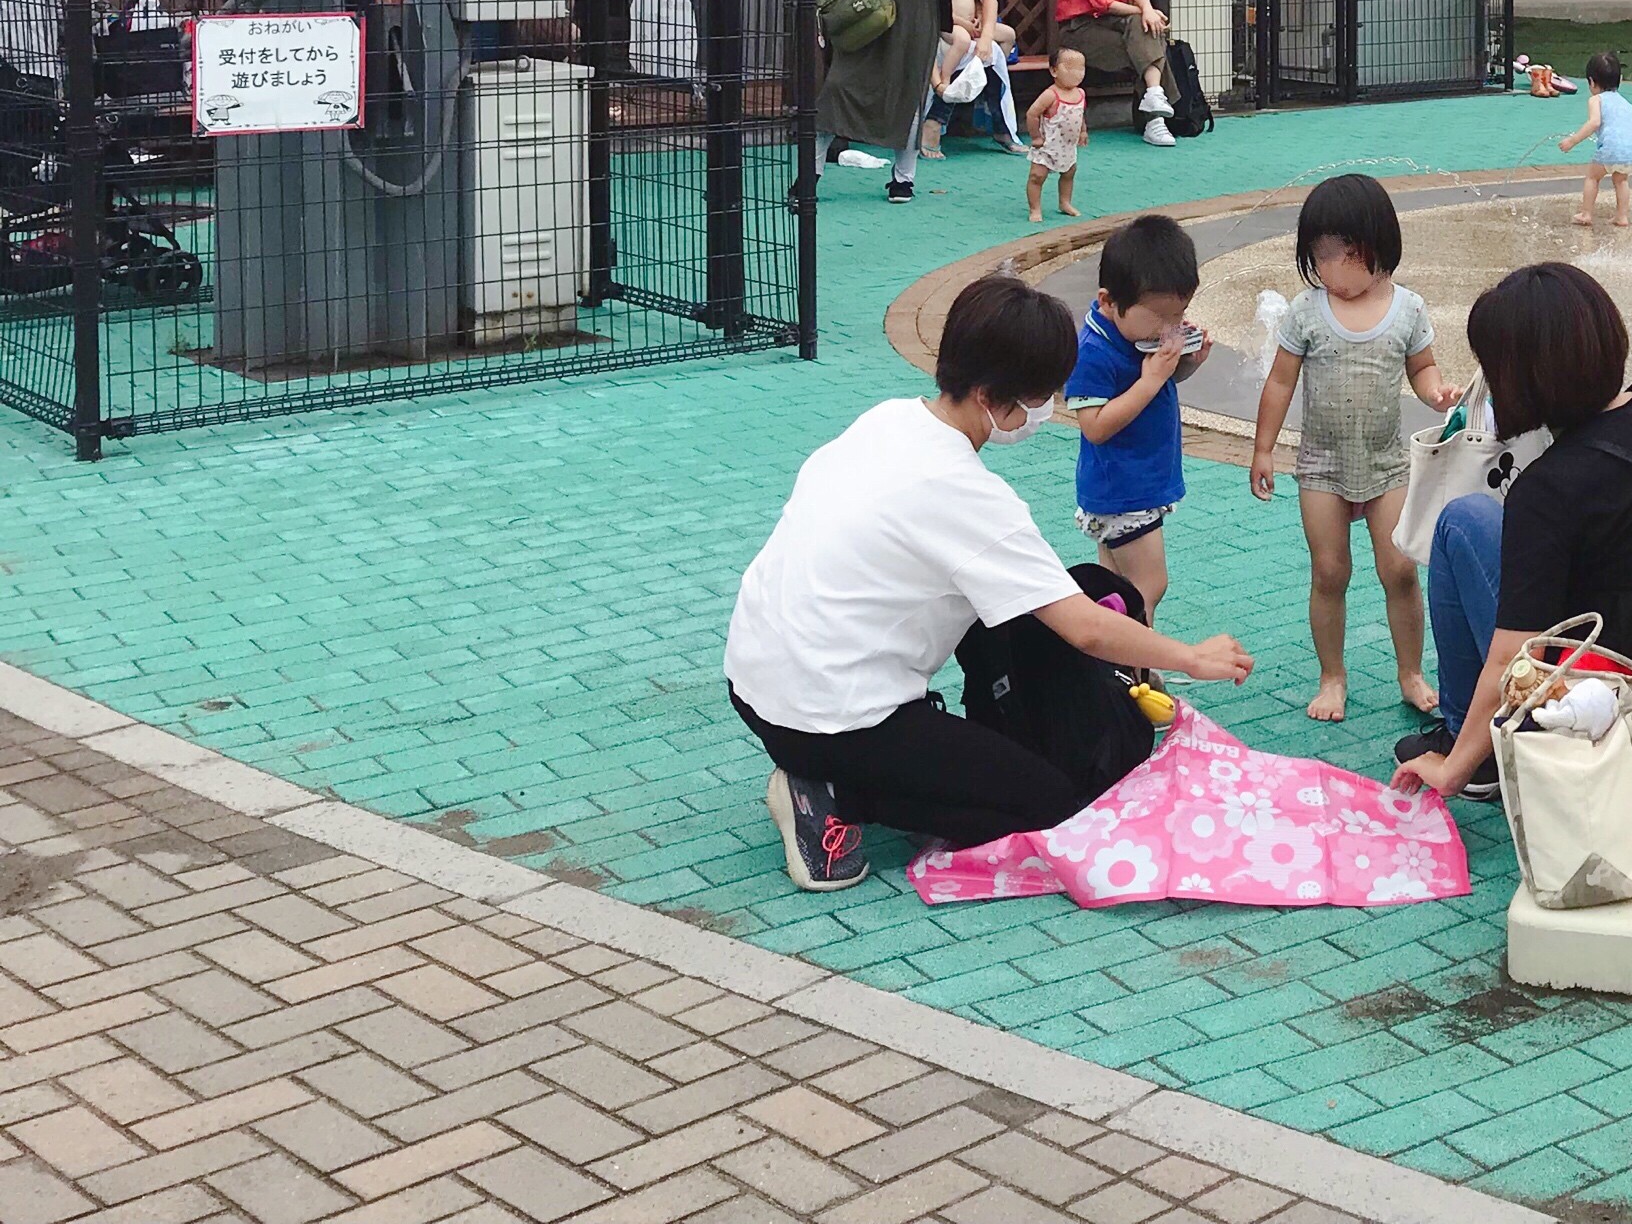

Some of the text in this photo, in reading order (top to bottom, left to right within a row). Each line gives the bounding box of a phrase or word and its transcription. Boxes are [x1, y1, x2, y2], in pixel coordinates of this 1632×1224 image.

[248, 19, 312, 36] おねがい
[218, 45, 339, 66] 受付をしてから
[231, 69, 327, 89] 遊びましょう
